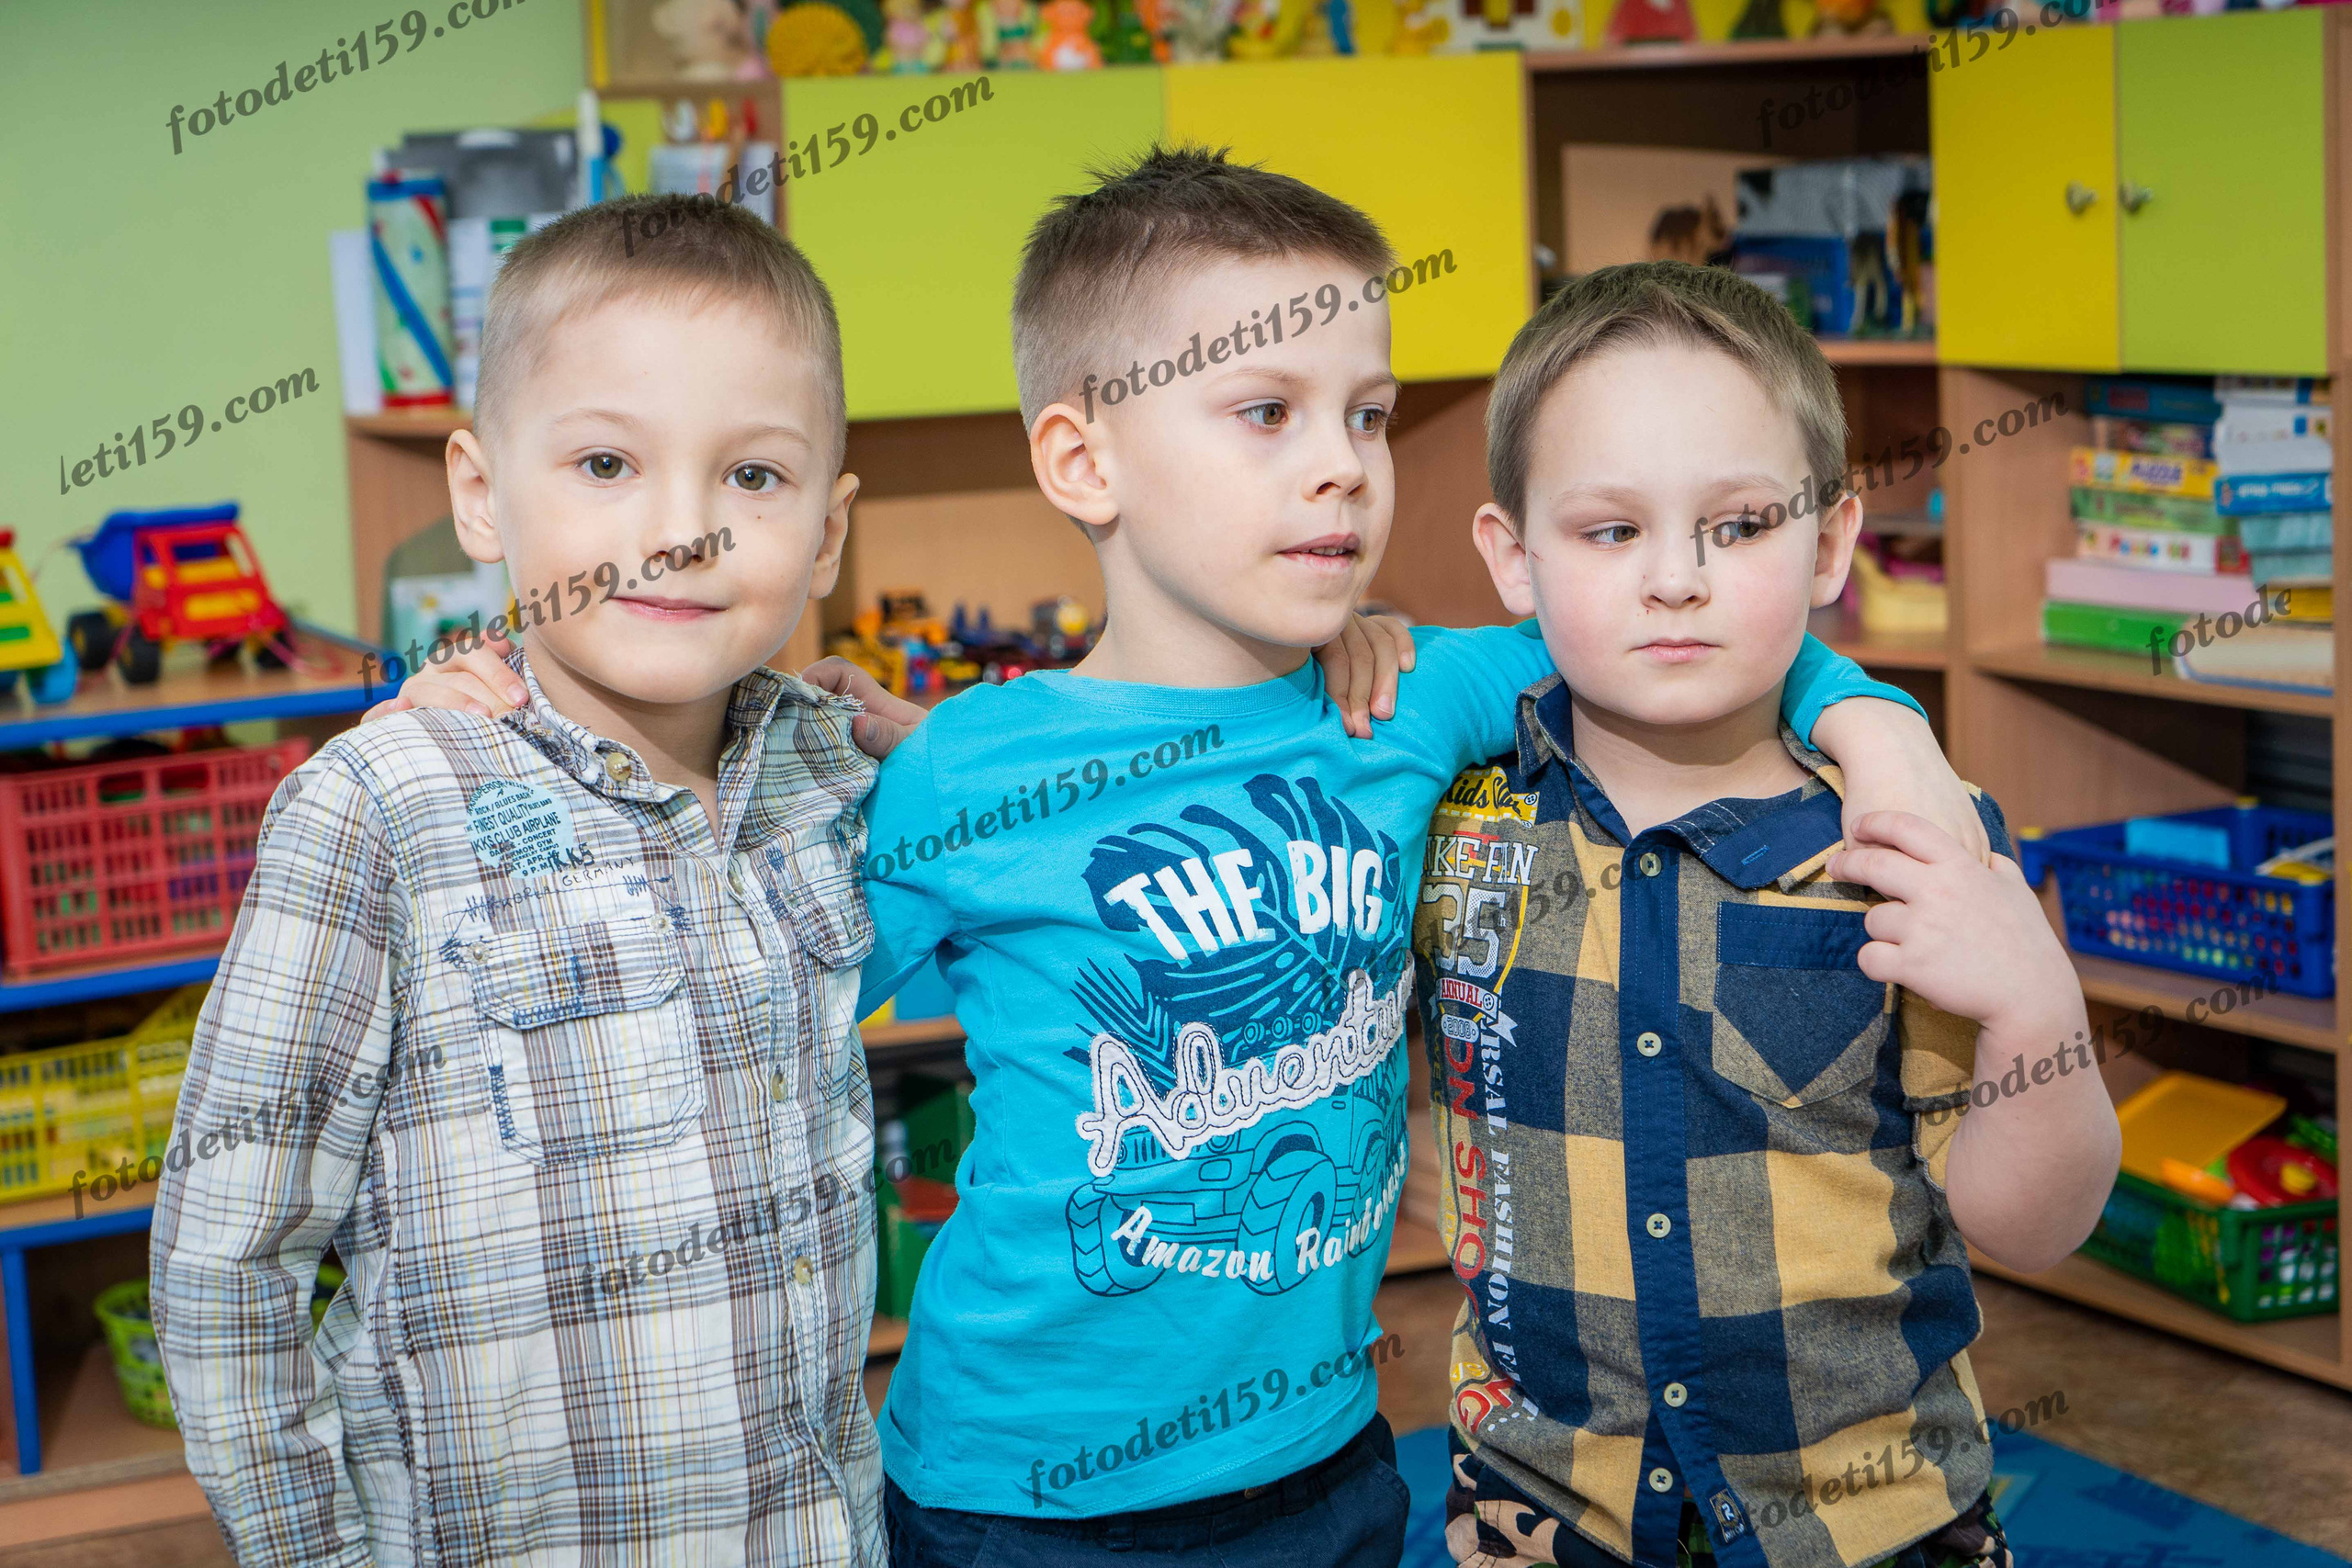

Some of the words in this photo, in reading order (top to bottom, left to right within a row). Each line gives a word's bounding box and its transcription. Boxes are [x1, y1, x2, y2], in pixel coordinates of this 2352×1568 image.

[494, 795, 516, 809] BLUES
[515, 791, 531, 801] BASH
[473, 815, 499, 834] FINEST
[497, 803, 531, 826] QUALITY
[493, 825, 523, 845] CLUB
[522, 811, 561, 835] AIRPLANE
[522, 829, 557, 845] CONCERT
[537, 838, 554, 849] GYM
[562, 856, 635, 886] GERMANY
[1103, 849, 1275, 969] THE
[1286, 840, 1383, 941] BIG
[1441, 978, 1483, 1008] ANNUAL
[1447, 1016, 1472, 1039] 2008
[1111, 1206, 1275, 1280] Amazon
[1487, 1148, 1513, 1330] FASHION
